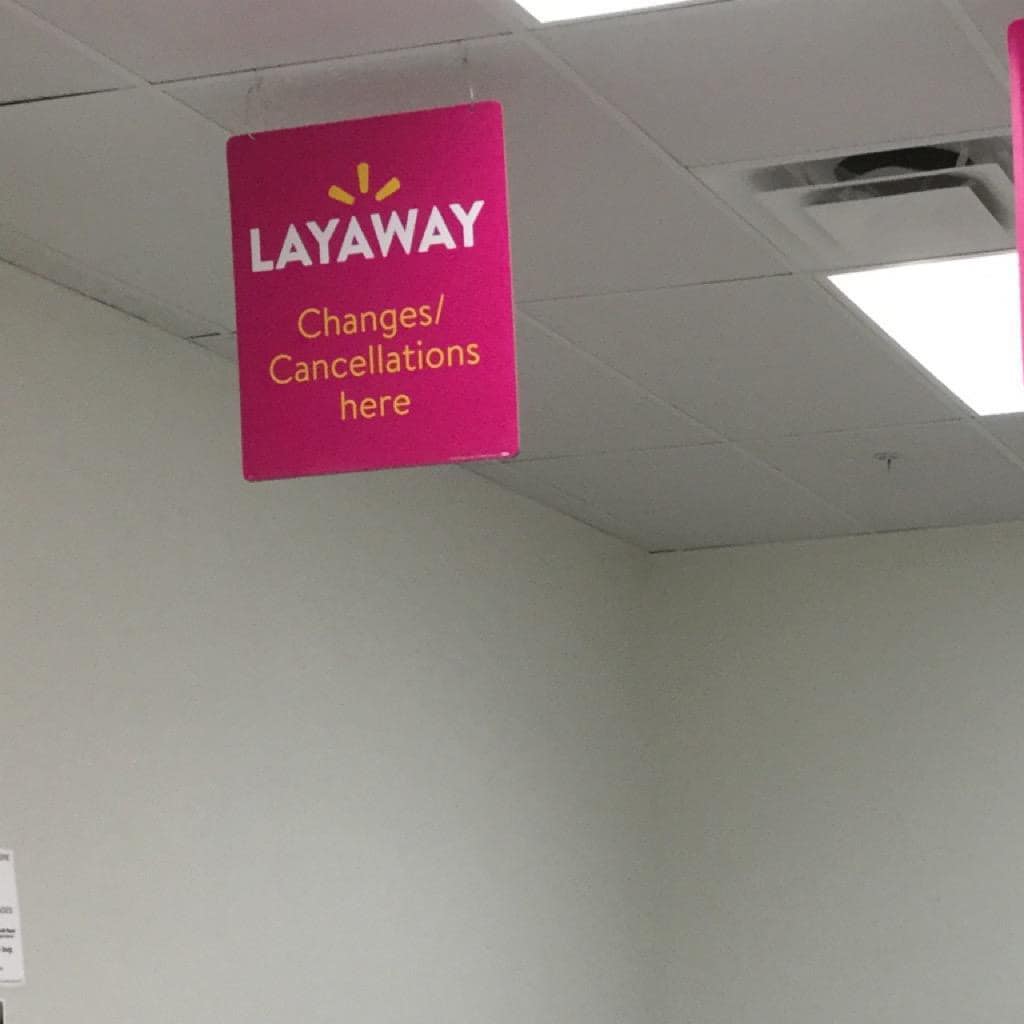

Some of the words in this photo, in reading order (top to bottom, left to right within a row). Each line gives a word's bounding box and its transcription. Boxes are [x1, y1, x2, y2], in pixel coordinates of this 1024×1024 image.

[249, 200, 485, 273] LAYAWAY
[298, 293, 445, 339] Changes/
[269, 340, 480, 385] Cancellations
[339, 391, 411, 421] here
